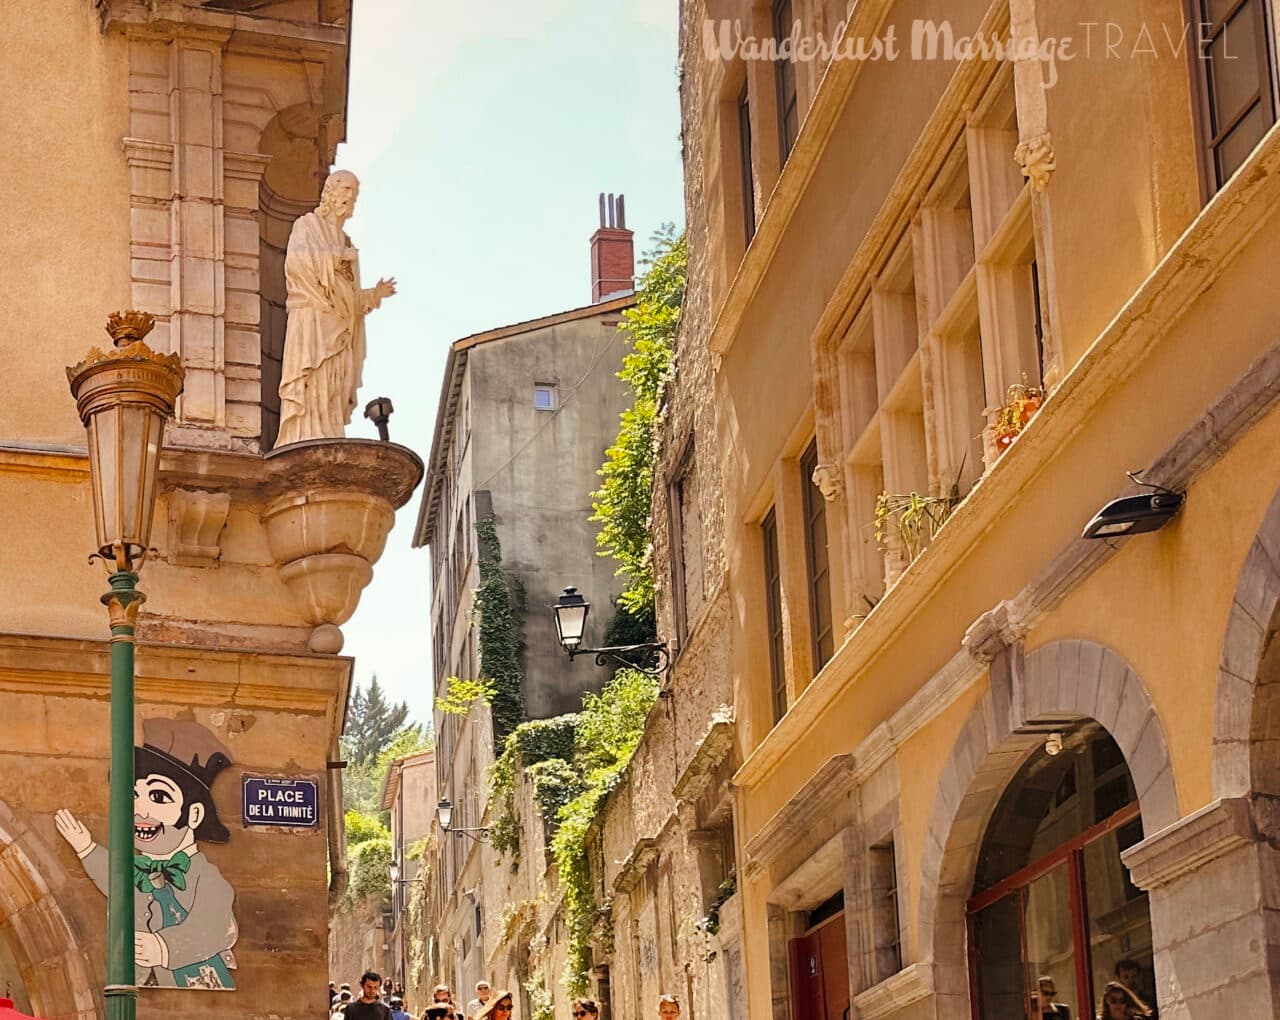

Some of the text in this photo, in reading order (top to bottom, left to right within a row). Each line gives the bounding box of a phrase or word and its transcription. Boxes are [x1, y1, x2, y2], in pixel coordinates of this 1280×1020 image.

[258, 789, 304, 803] PLACE
[249, 804, 313, 819] DE LA TRINITÉ
